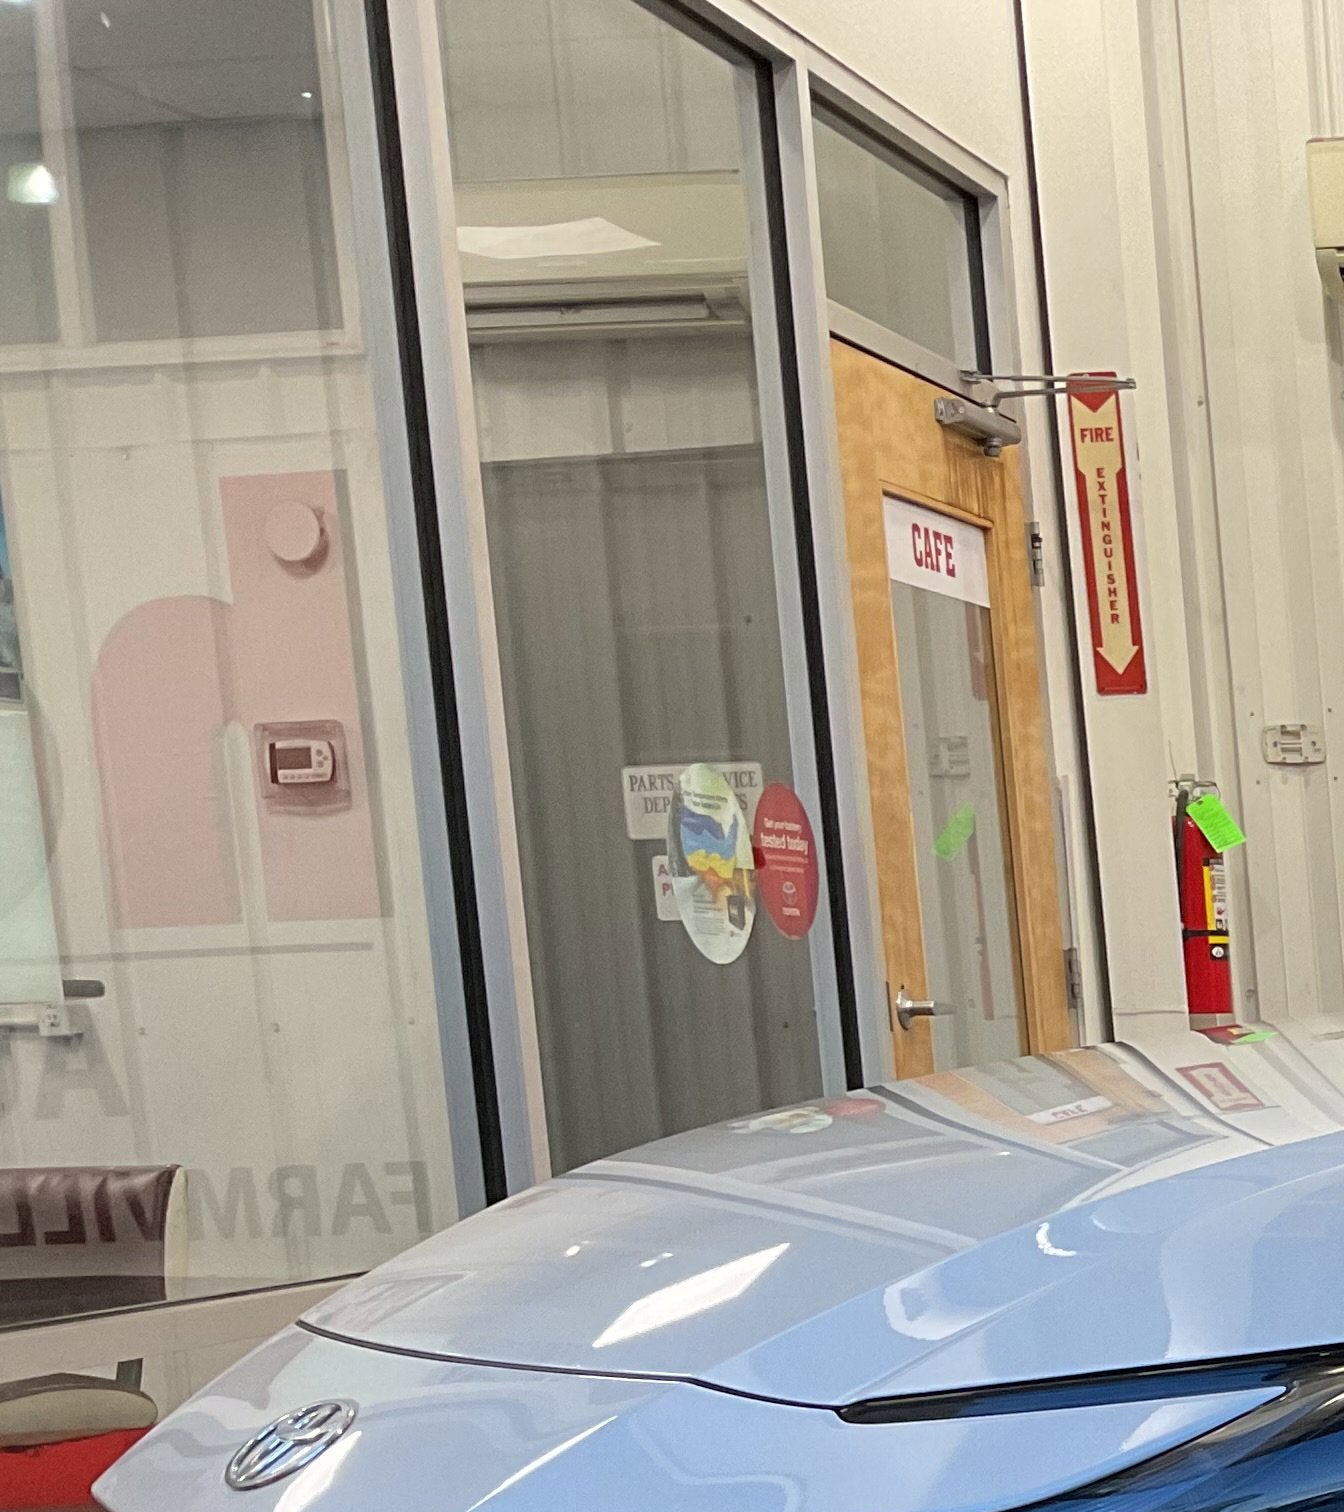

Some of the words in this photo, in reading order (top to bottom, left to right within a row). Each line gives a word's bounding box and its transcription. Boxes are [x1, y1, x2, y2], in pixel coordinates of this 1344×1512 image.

[1080, 426, 1114, 444] FIRE
[911, 523, 956, 578] CAFE
[1096, 467, 1121, 625] EXTINGUISHER
[629, 773, 675, 792] PARTS
